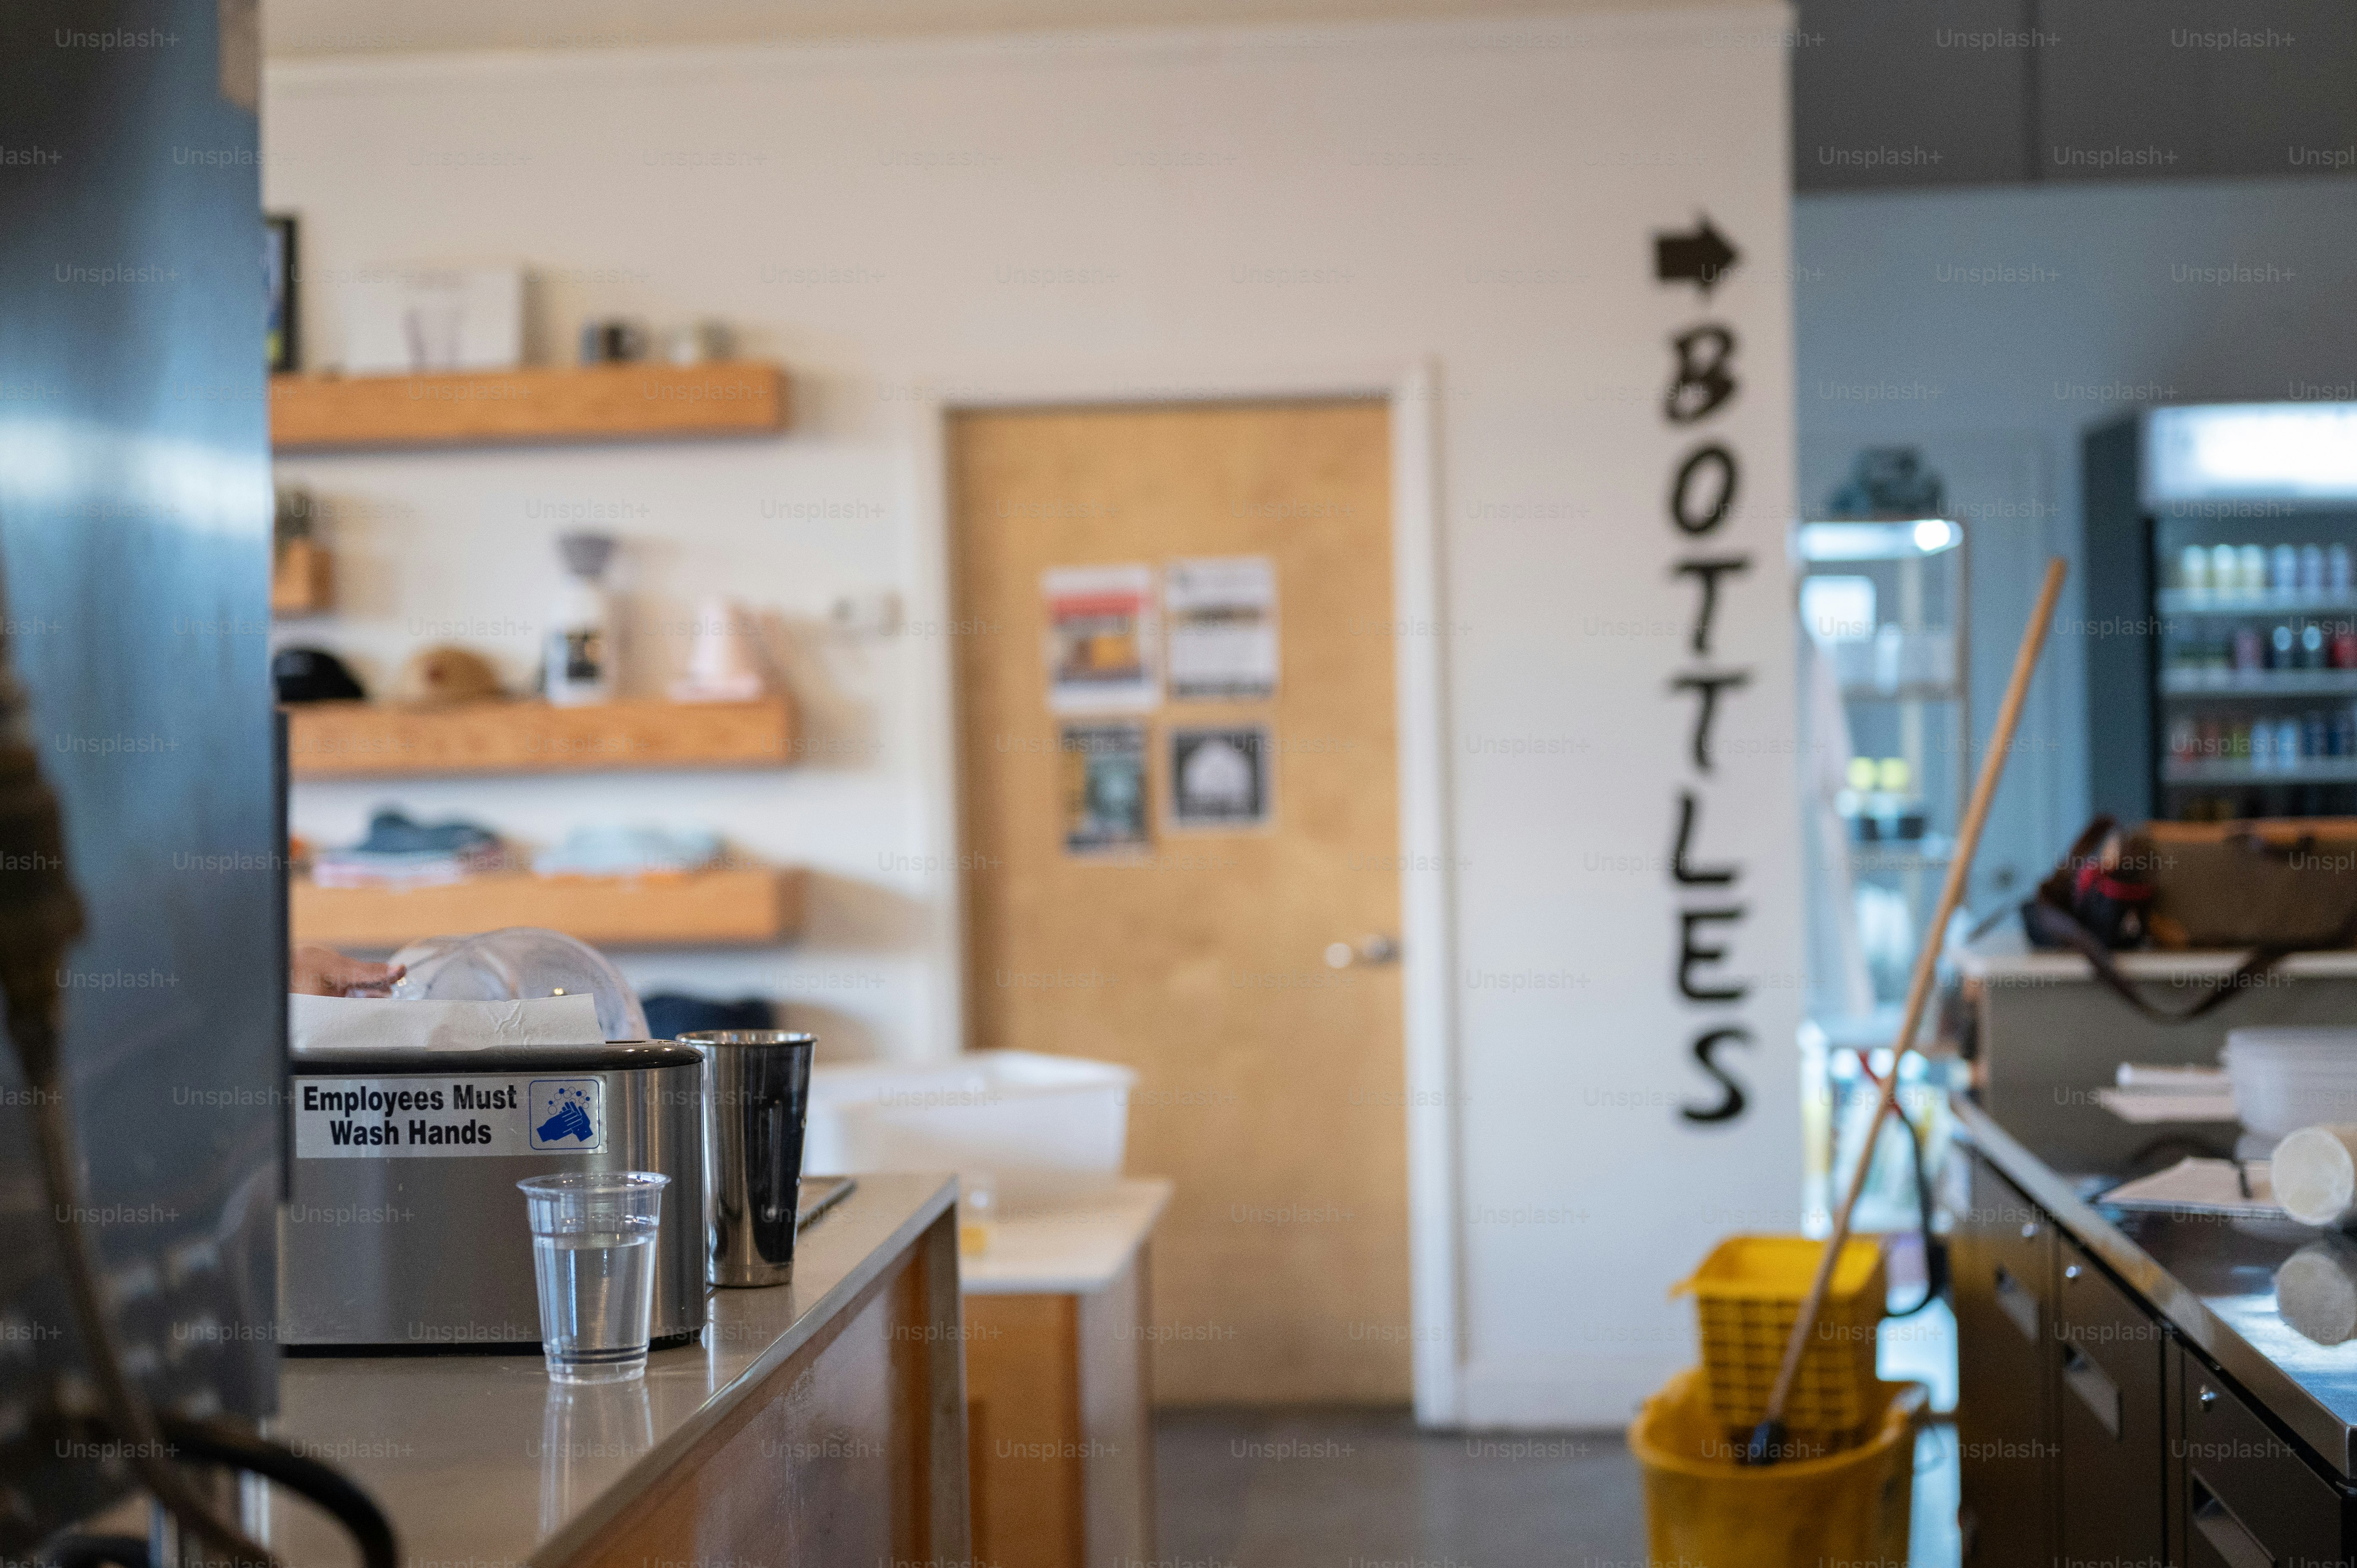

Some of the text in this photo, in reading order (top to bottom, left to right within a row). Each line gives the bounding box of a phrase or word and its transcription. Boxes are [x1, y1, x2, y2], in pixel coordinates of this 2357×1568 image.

[1664, 323, 1752, 1124] BOTTLES
[304, 1086, 443, 1117] Employees
[453, 1085, 517, 1110] Must
[330, 1119, 491, 1145] Wash Hands
